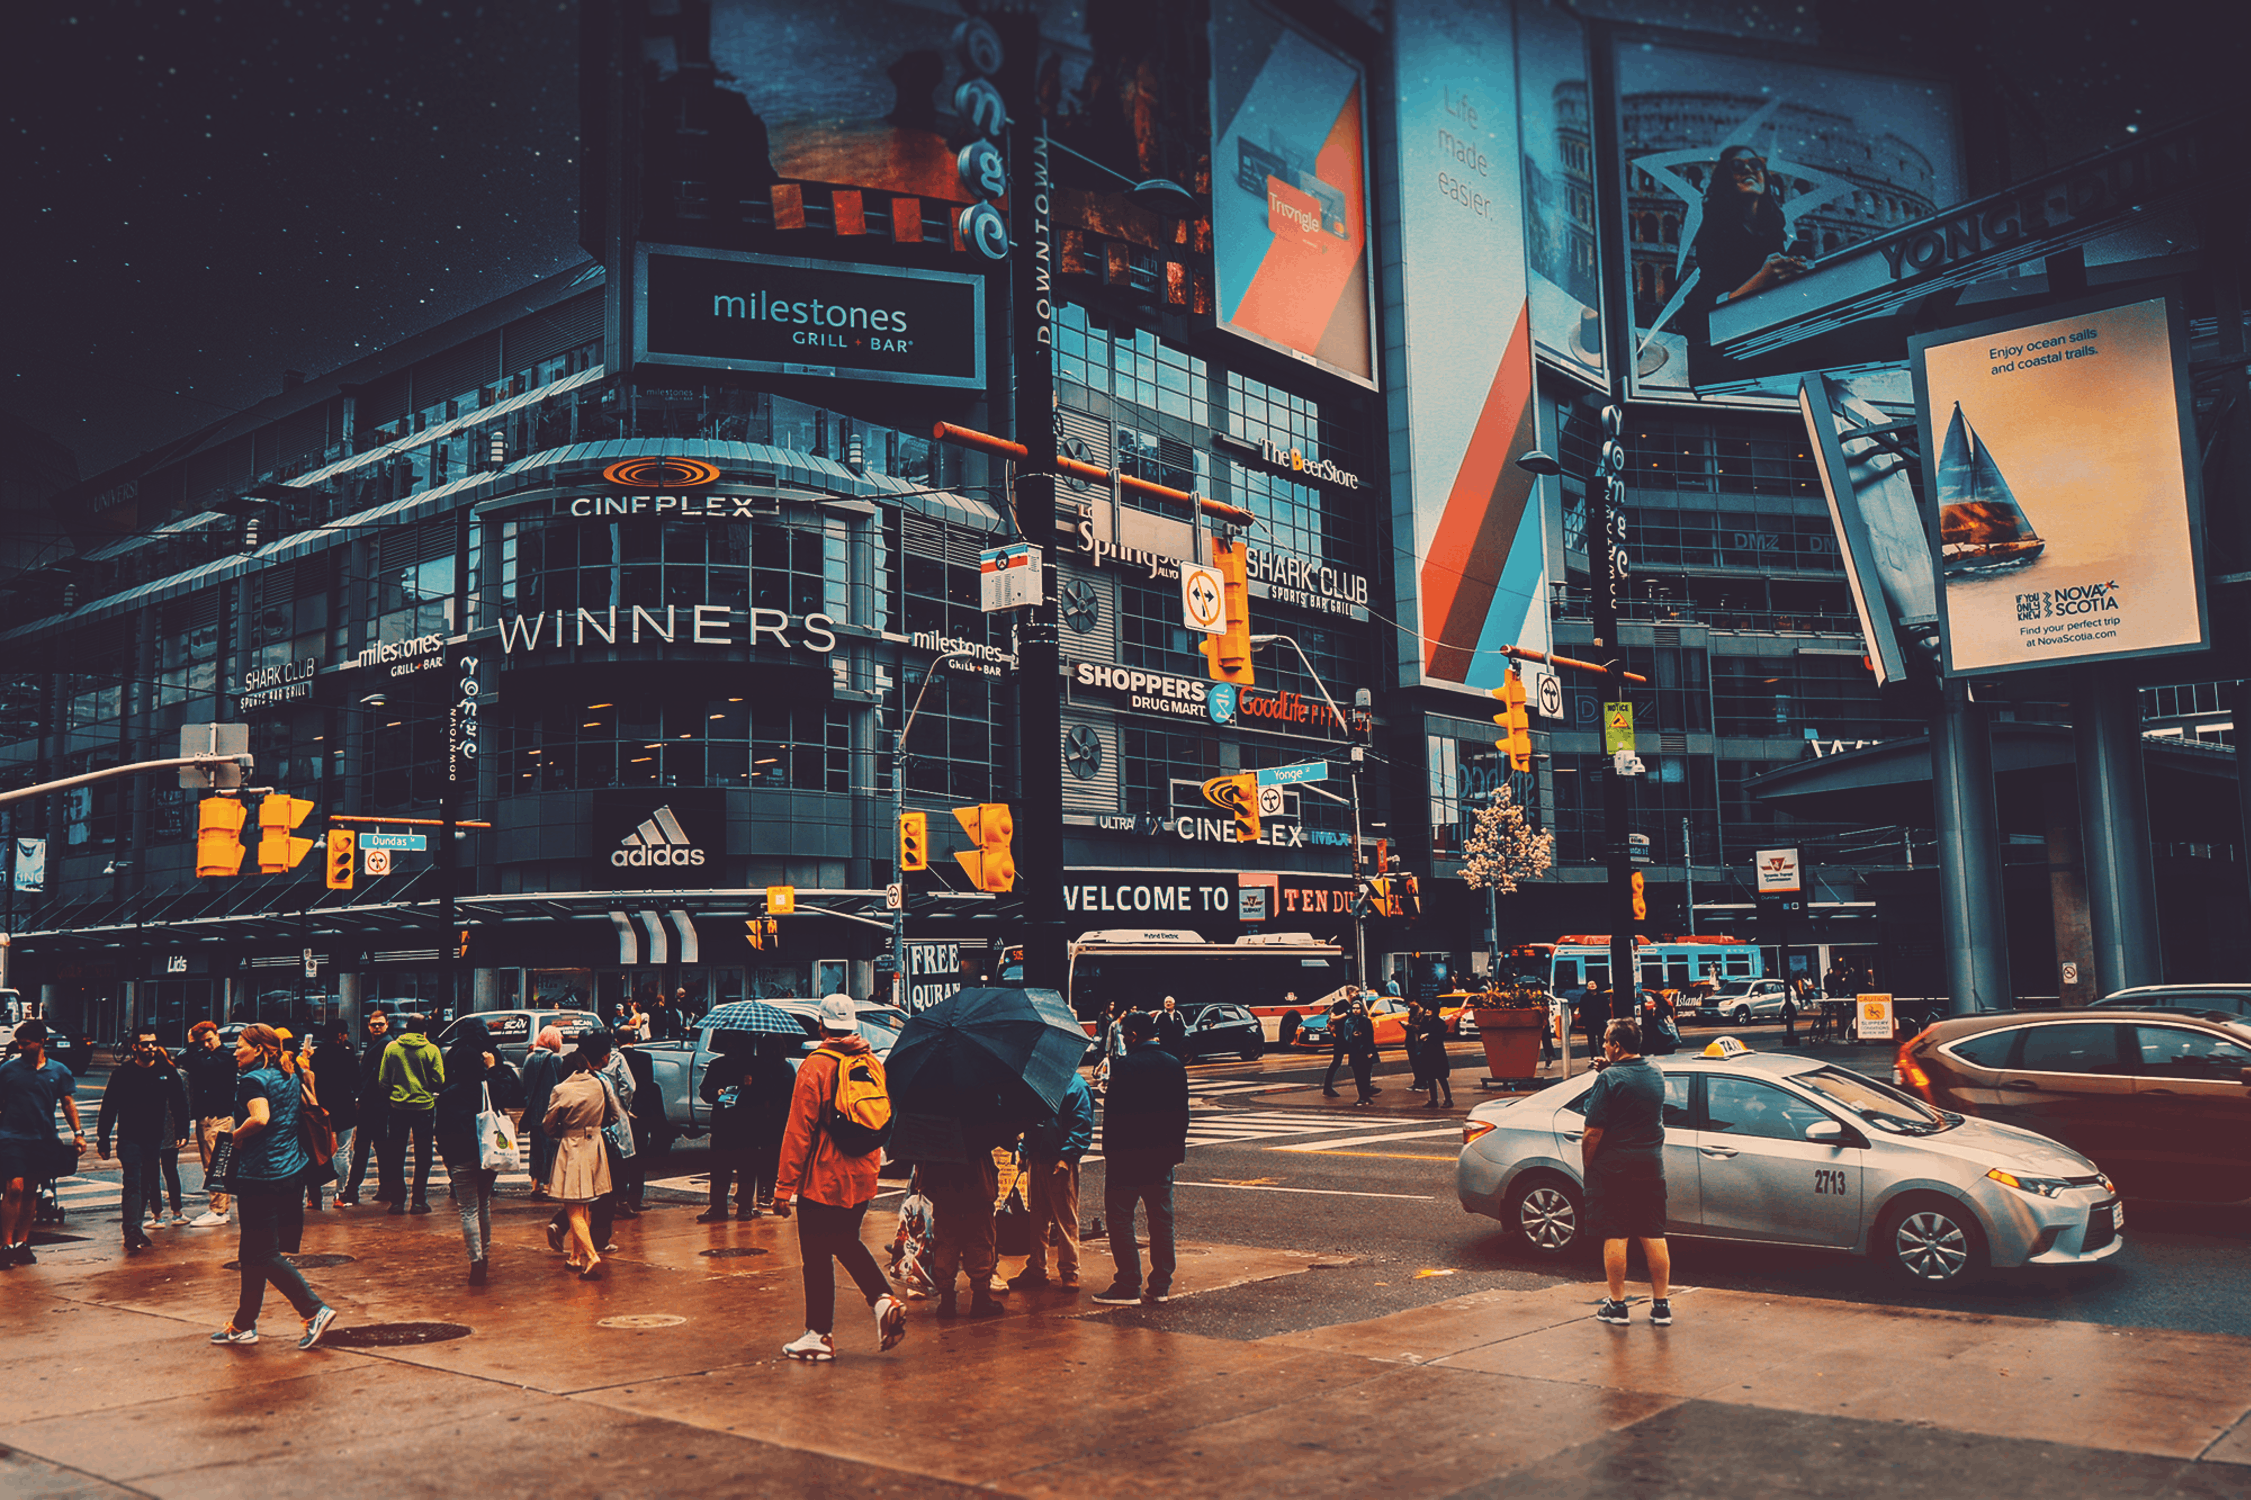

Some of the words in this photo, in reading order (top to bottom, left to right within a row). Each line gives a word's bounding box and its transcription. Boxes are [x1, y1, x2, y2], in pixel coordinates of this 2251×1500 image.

[1443, 85, 1478, 130] Life
[1438, 129, 1488, 177] made
[1035, 136, 1051, 346] DOWNTOWN
[714, 290, 908, 333] milestones
[792, 331, 848, 349] GRILL
[1989, 345, 2023, 359] Enjoy
[2026, 336, 2067, 351] ocean
[2068, 328, 2098, 343] sails
[1991, 361, 2015, 375] and
[2017, 351, 2063, 370] coastal
[2065, 345, 2099, 360] trails.
[570, 496, 754, 518] CINEPLEX
[1734, 533, 1780, 550] DMZ
[1246, 546, 1315, 593] SHARK
[1320, 566, 1368, 605] CLUB
[1271, 585, 1307, 608] SPORTS
[1309, 594, 1329, 611] BAR
[1330, 600, 1354, 617] GRILL
[2015, 594, 2023, 603] IF
[2024, 592, 2040, 602] YOU
[2054, 584, 2104, 602] NOVA
[2016, 601, 2041, 612] ONLY
[2017, 610, 2041, 621] KNEW
[2055, 596, 2119, 616] SCOTIA
[497, 603, 837, 654] WINNERS
[2020, 625, 2041, 635] Find
[2043, 624, 2065, 635] your
[2067, 618, 2102, 631] perfect
[2104, 616, 2121, 627] trip
[357, 630, 443, 668] milestones
[912, 629, 1002, 663] milestones
[2026, 639, 2036, 647] at
[2037, 629, 2117, 646] NovaScotia.com
[245, 665, 282, 692] SHARK
[284, 657, 315, 682] CLUB
[390, 663, 415, 677] GRILL
[423, 656, 444, 670] BAR
[983, 664, 1002, 677] BAR
[1077, 663, 1207, 702] SHOPPERS
[1132, 695, 1170, 712] DRUG
[1170, 700, 1207, 718] MART
[1238, 686, 1306, 723] GoodLife
[1607, 704, 1629, 712] NOTICE
[448, 708, 458, 782] DOWNTOWN
[1273, 769, 1303, 782] Yonge
[1099, 815, 1136, 831] ULTRA
[1176, 816, 1303, 848] CINELEX
[372, 835, 407, 846] Dundas
[1310, 831, 1350, 847] IMAX
[610, 843, 706, 867] adidas
[1198, 885, 1229, 912] TO
[1284, 888, 1329, 913] TEN
[167, 955, 188, 973] Lids
[910, 943, 960, 975] FREE
[1675, 990, 1704, 1007] Island
[503, 1018, 527, 1030] SCAN
[571, 1019, 594, 1028] SCAN
[1815, 1169, 1846, 1196] 2713
